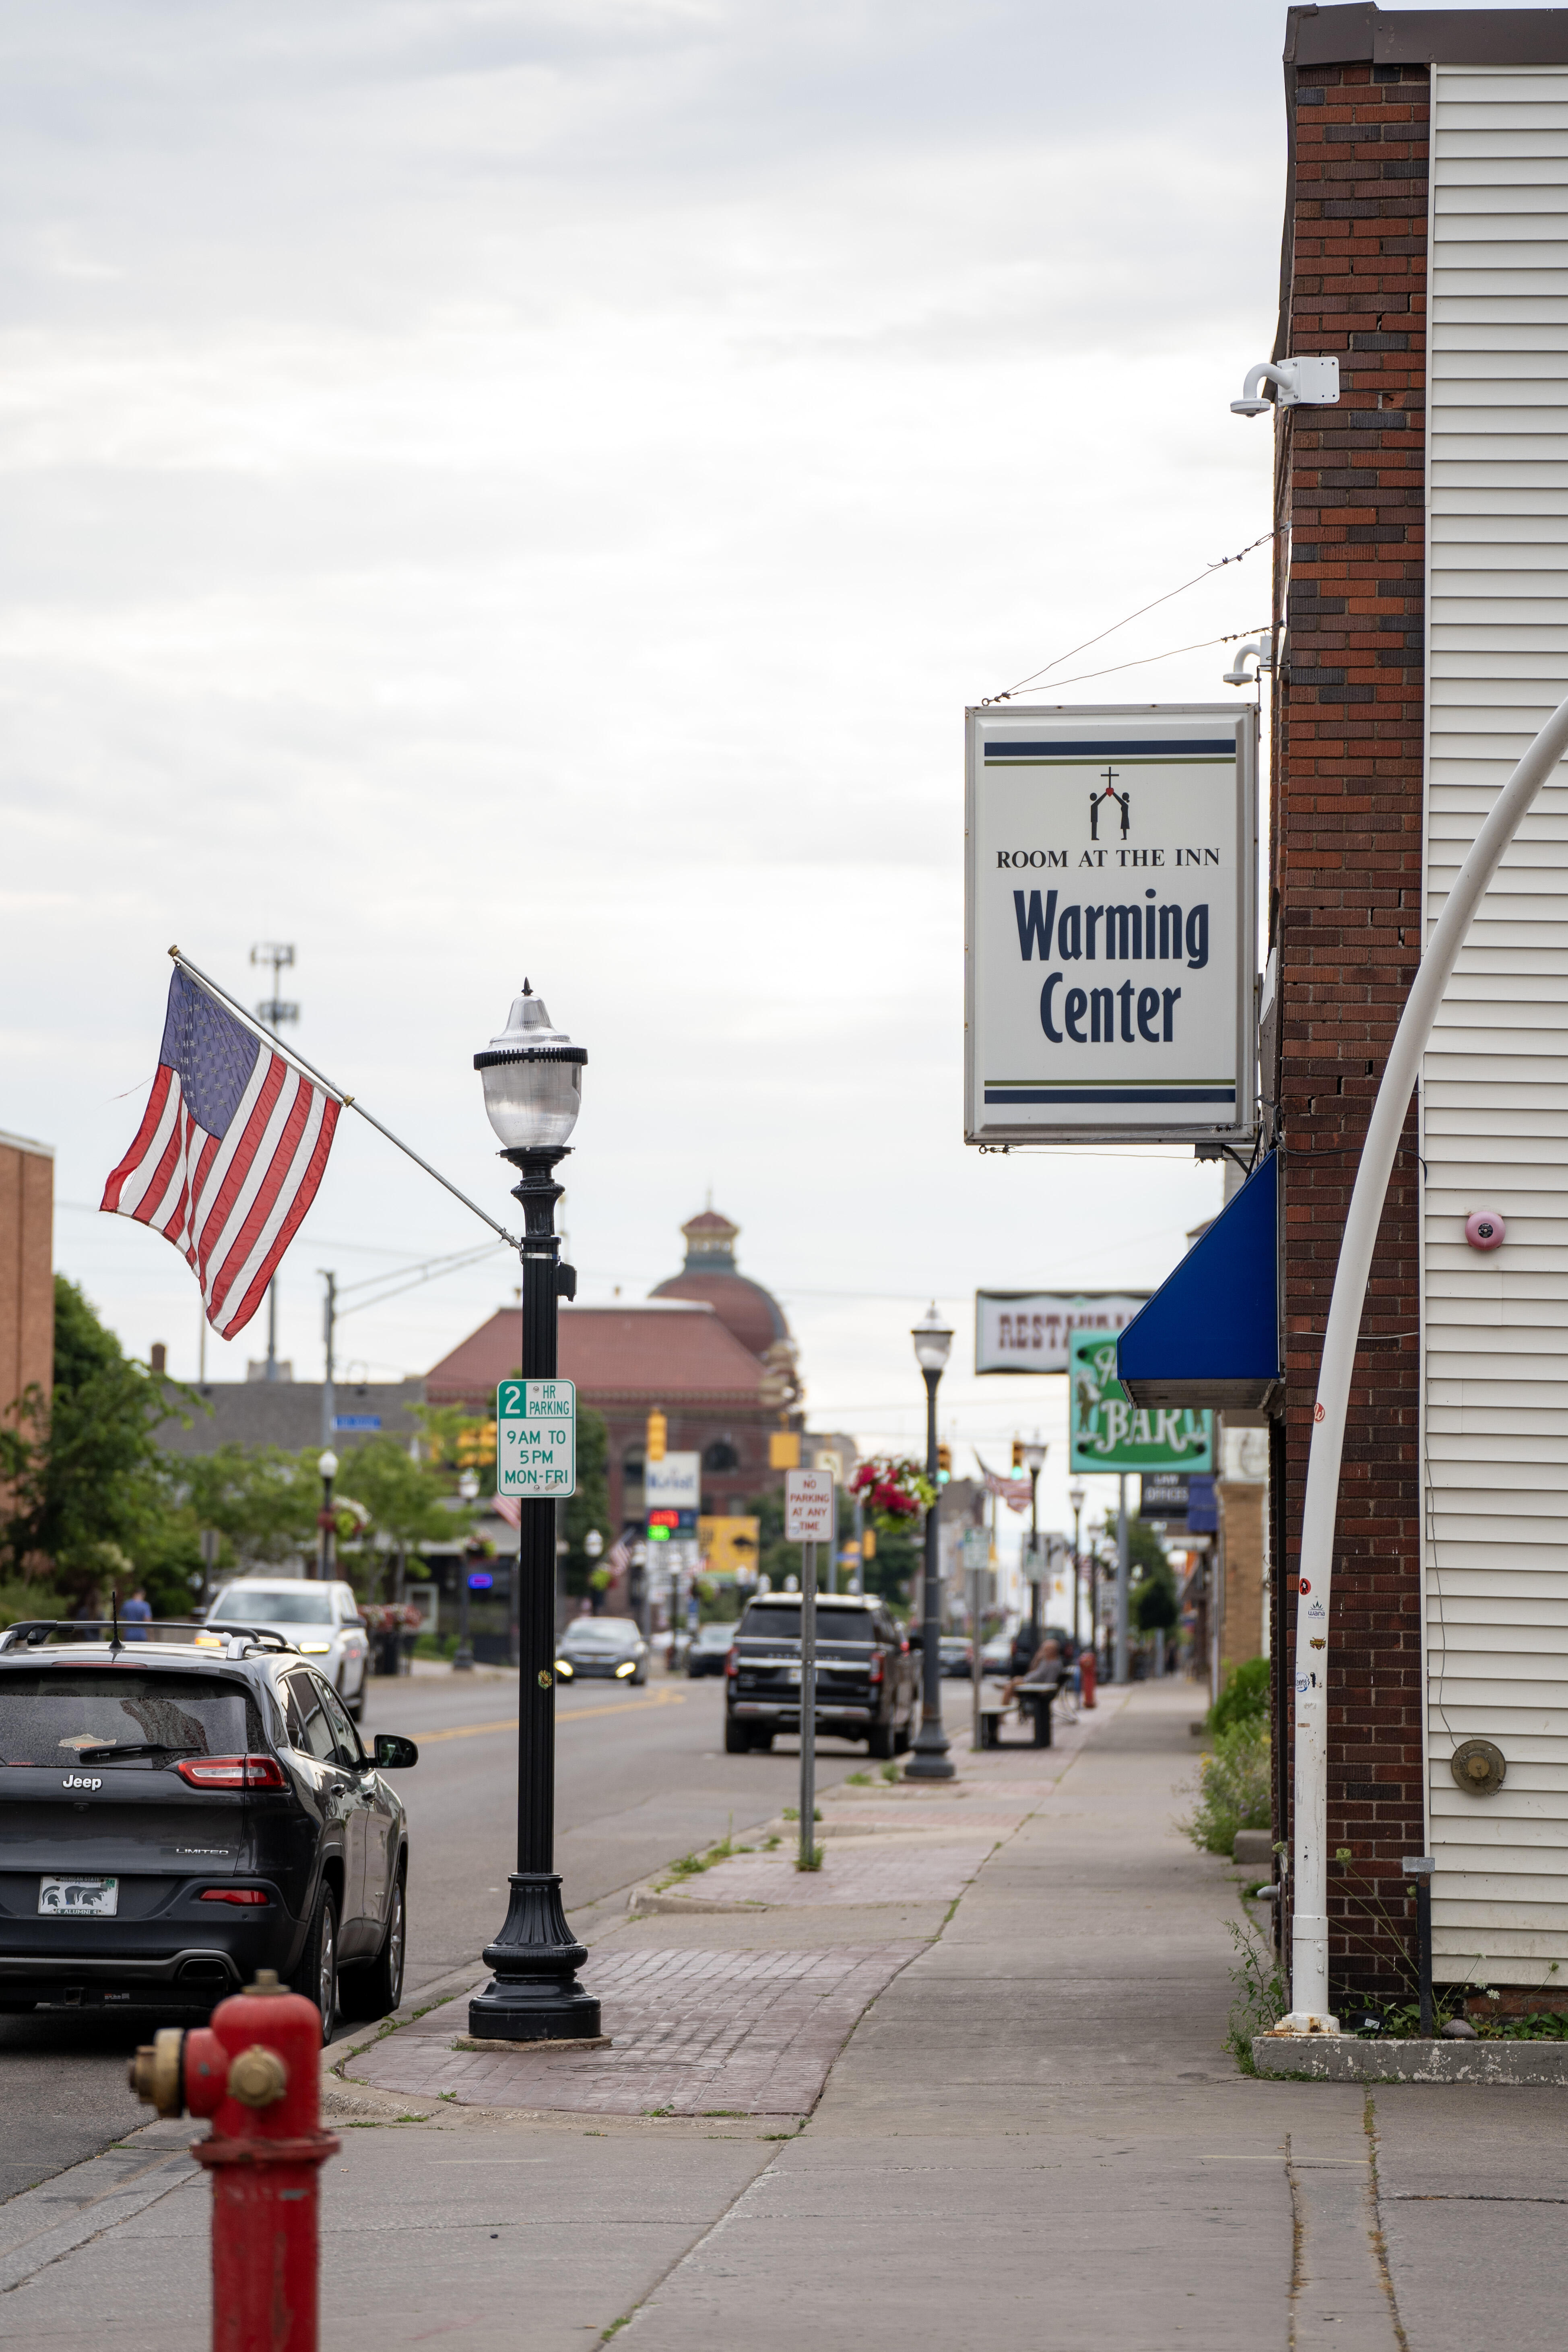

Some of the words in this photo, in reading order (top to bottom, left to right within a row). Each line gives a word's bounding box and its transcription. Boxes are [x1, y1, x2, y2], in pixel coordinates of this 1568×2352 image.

[996, 850, 1069, 869] ROOM
[1078, 850, 1108, 868] AT
[1116, 849, 1165, 867] THE
[1175, 848, 1220, 866] INN
[1013, 888, 1209, 970] Warming
[1040, 972, 1181, 1043] Center
[543, 1385, 556, 1399] HR
[505, 1386, 520, 1414] 2
[530, 1401, 569, 1415] PARKING
[1094, 1398, 1188, 1454] BAR
[507, 1430, 541, 1444] 9AM
[549, 1430, 566, 1444] TO
[520, 1450, 553, 1464] 5PM
[505, 1470, 567, 1484] MON-FRI
[803, 1479, 817, 1489] NO
[790, 1493, 830, 1503] PARKING
[792, 1507, 803, 1517] AT
[807, 1507, 828, 1517] ANY
[799, 1521, 820, 1531] TIME
[1296, 1678, 1310, 1688] enny's
[62, 1774, 102, 1791] Jeep
